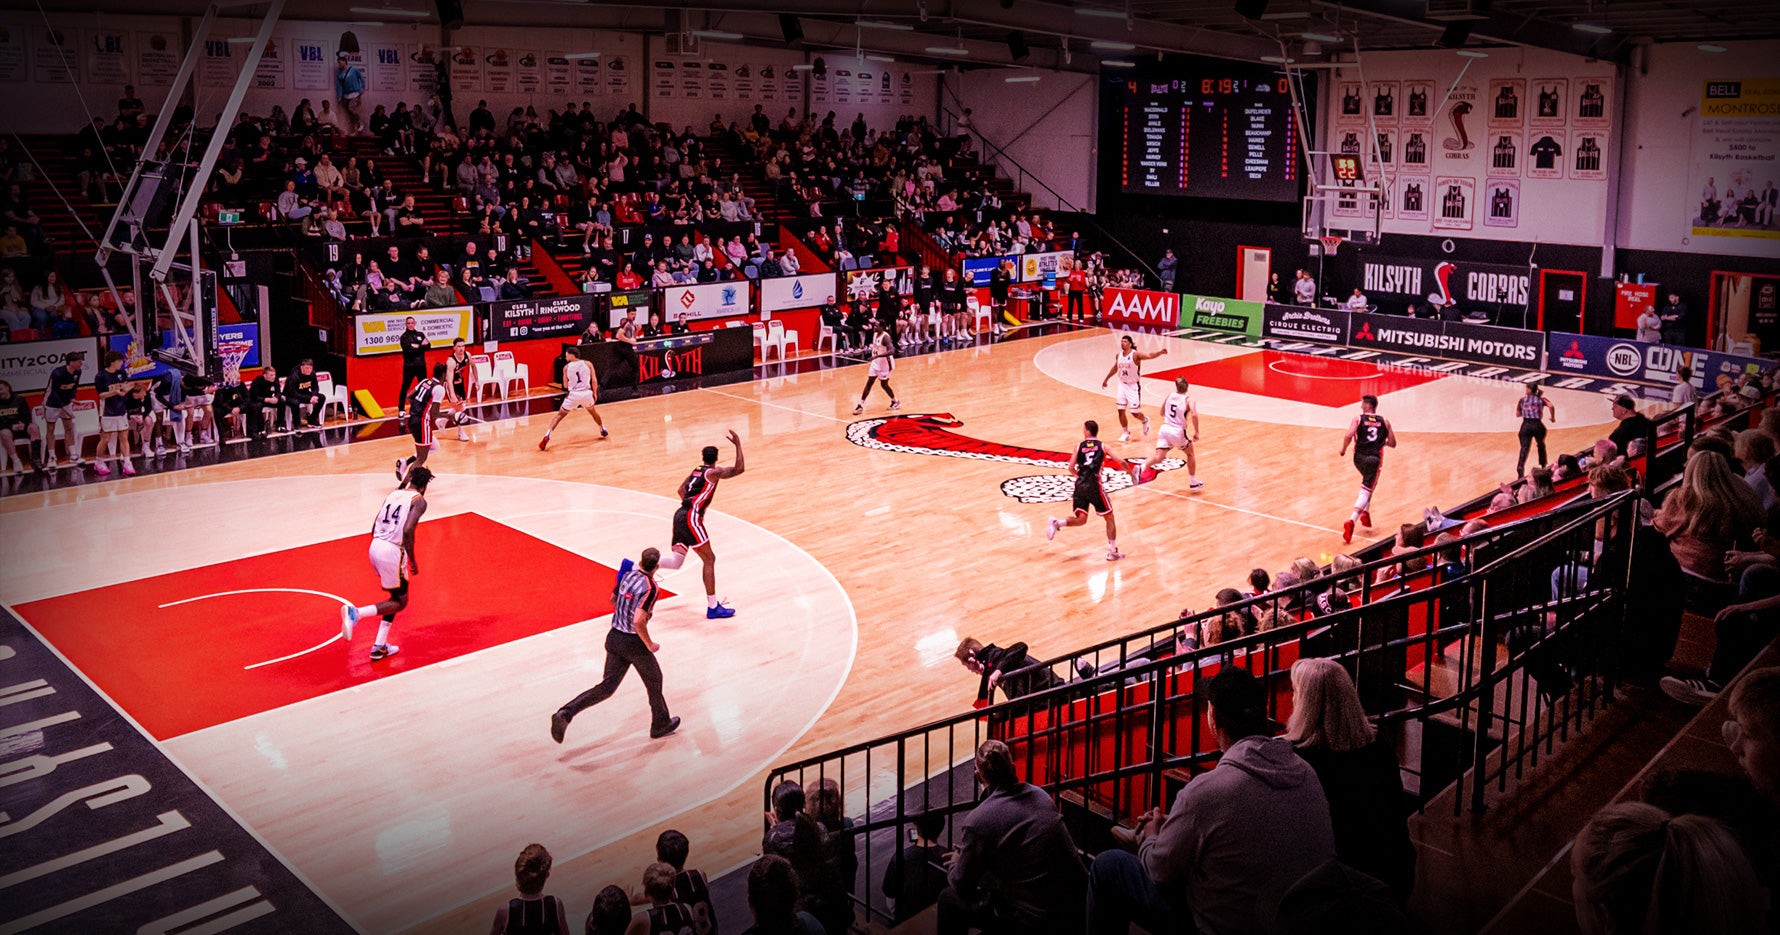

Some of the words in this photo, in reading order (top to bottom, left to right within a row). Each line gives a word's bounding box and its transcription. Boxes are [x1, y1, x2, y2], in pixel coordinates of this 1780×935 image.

[300, 45, 324, 62] VBL
[378, 49, 400, 64] VBL
[1128, 81, 1137, 93] 4
[1201, 79, 1232, 94] 8:19
[1278, 78, 1288, 93] 0
[1709, 85, 1738, 96] BELL
[1710, 153, 1733, 162] Kilsyth
[497, 235, 506, 252] 18
[623, 229, 630, 245] 17
[328, 244, 339, 262] 19
[1364, 263, 1422, 295] KILSYTH
[1467, 271, 1529, 305] COBRAS
[504, 308, 534, 319] KILSYTH
[540, 304, 581, 315] RINGWOOD
[1108, 292, 1173, 322] AAMI
[1195, 297, 1225, 315] Kayo
[421, 317, 455, 325] COMMERCIAL
[1196, 315, 1245, 329] FREEBIES
[364, 336, 384, 345] 1300
[386, 335, 400, 343] 969
[1377, 328, 1465, 352] MITSUBISHI
[1467, 339, 1536, 361] MOTORS
[1614, 352, 1633, 366] NBL
[575, 371, 583, 383] 1
[1169, 404, 1178, 418] 5
[1366, 426, 1379, 442] 3
[1083, 451, 1096, 466] 5
[382, 503, 402, 525] 14
